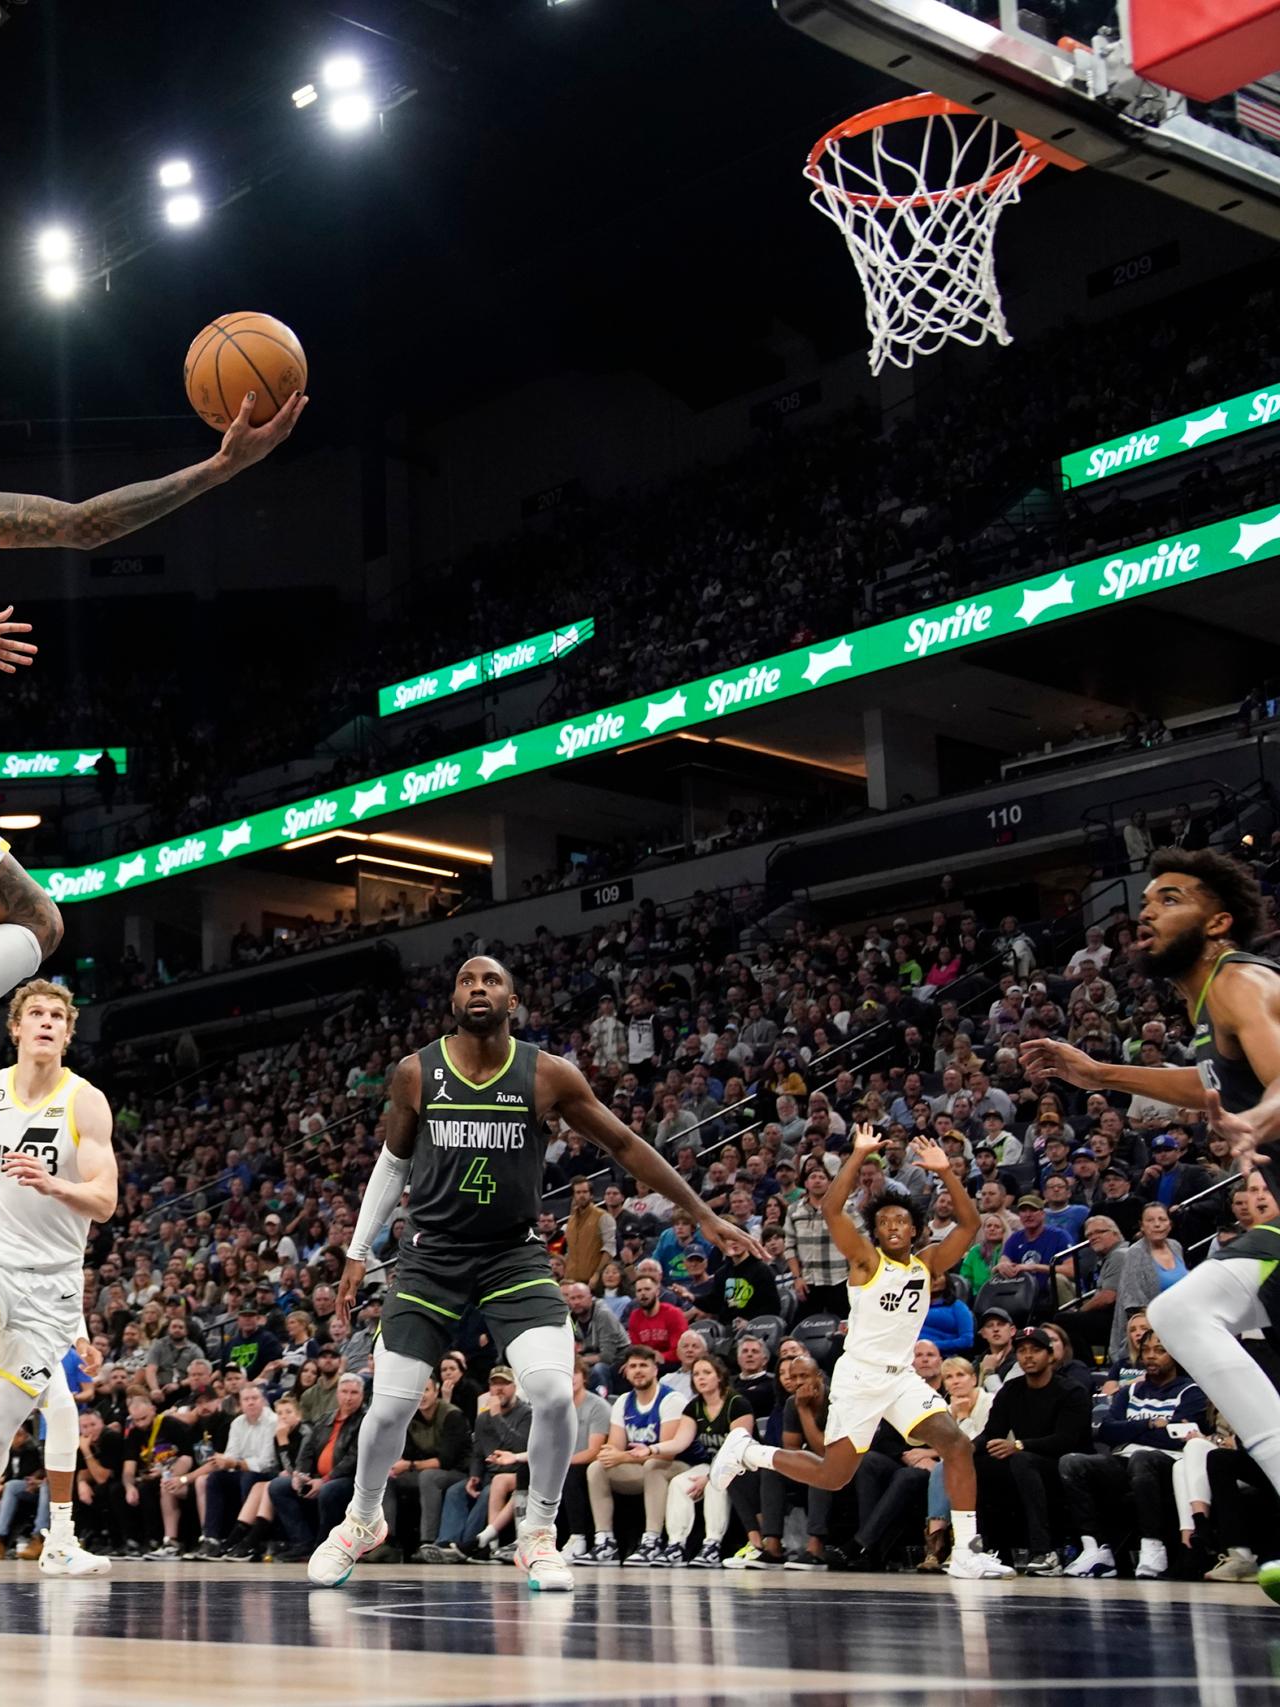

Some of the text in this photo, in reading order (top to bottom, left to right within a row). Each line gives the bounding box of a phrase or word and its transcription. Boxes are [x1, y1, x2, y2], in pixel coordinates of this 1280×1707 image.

[1086, 434, 1160, 478] Sprite
[393, 644, 537, 710] Sprite Sprite
[45, 868, 106, 901] Sprite
[155, 838, 206, 876] Sprite
[281, 798, 338, 839] Sprite
[399, 761, 461, 804] Sprite
[555, 712, 625, 759] Sprite
[704, 666, 782, 715] Sprite
[904, 602, 993, 656] Sprite
[1098, 541, 1202, 600] Sprite
[2, 753, 60, 778] Sprite
[987, 805, 1022, 828] 110
[593, 885, 620, 905] 109
[433, 1068, 444, 1080] 6
[427, 1119, 527, 1153] TIMBERWOLVES
[458, 1156, 496, 1205] 4
[907, 1291, 920, 1313] 2
